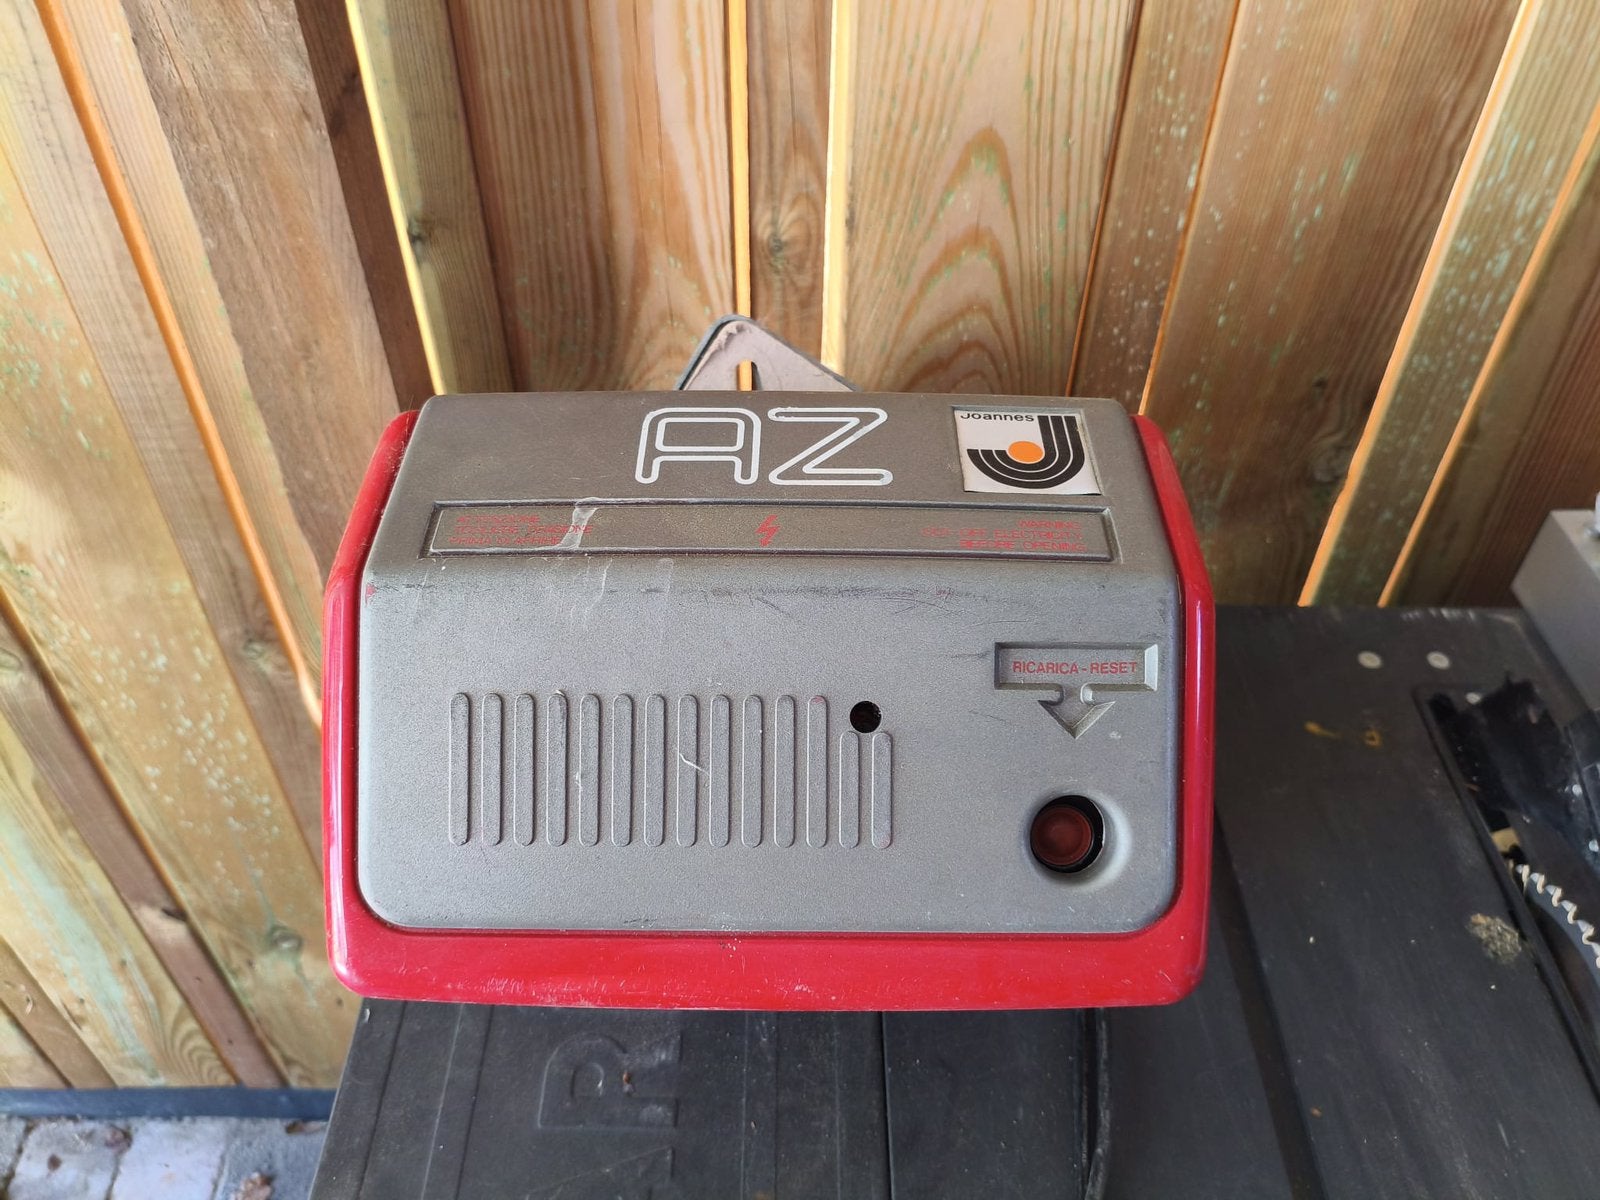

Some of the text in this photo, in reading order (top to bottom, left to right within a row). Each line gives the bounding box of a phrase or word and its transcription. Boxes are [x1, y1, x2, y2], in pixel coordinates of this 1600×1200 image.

[960, 412, 1035, 422] Joannes
[634, 407, 894, 486] AZ
[1016, 519, 1083, 529] WARNING
[958, 528, 987, 537] OFF
[993, 529, 1083, 540] ELECTRICITY
[959, 540, 1087, 552] BEFORE OPENING
[1012, 661, 1079, 674] RICARICA
[1089, 661, 1138, 675] RESET
